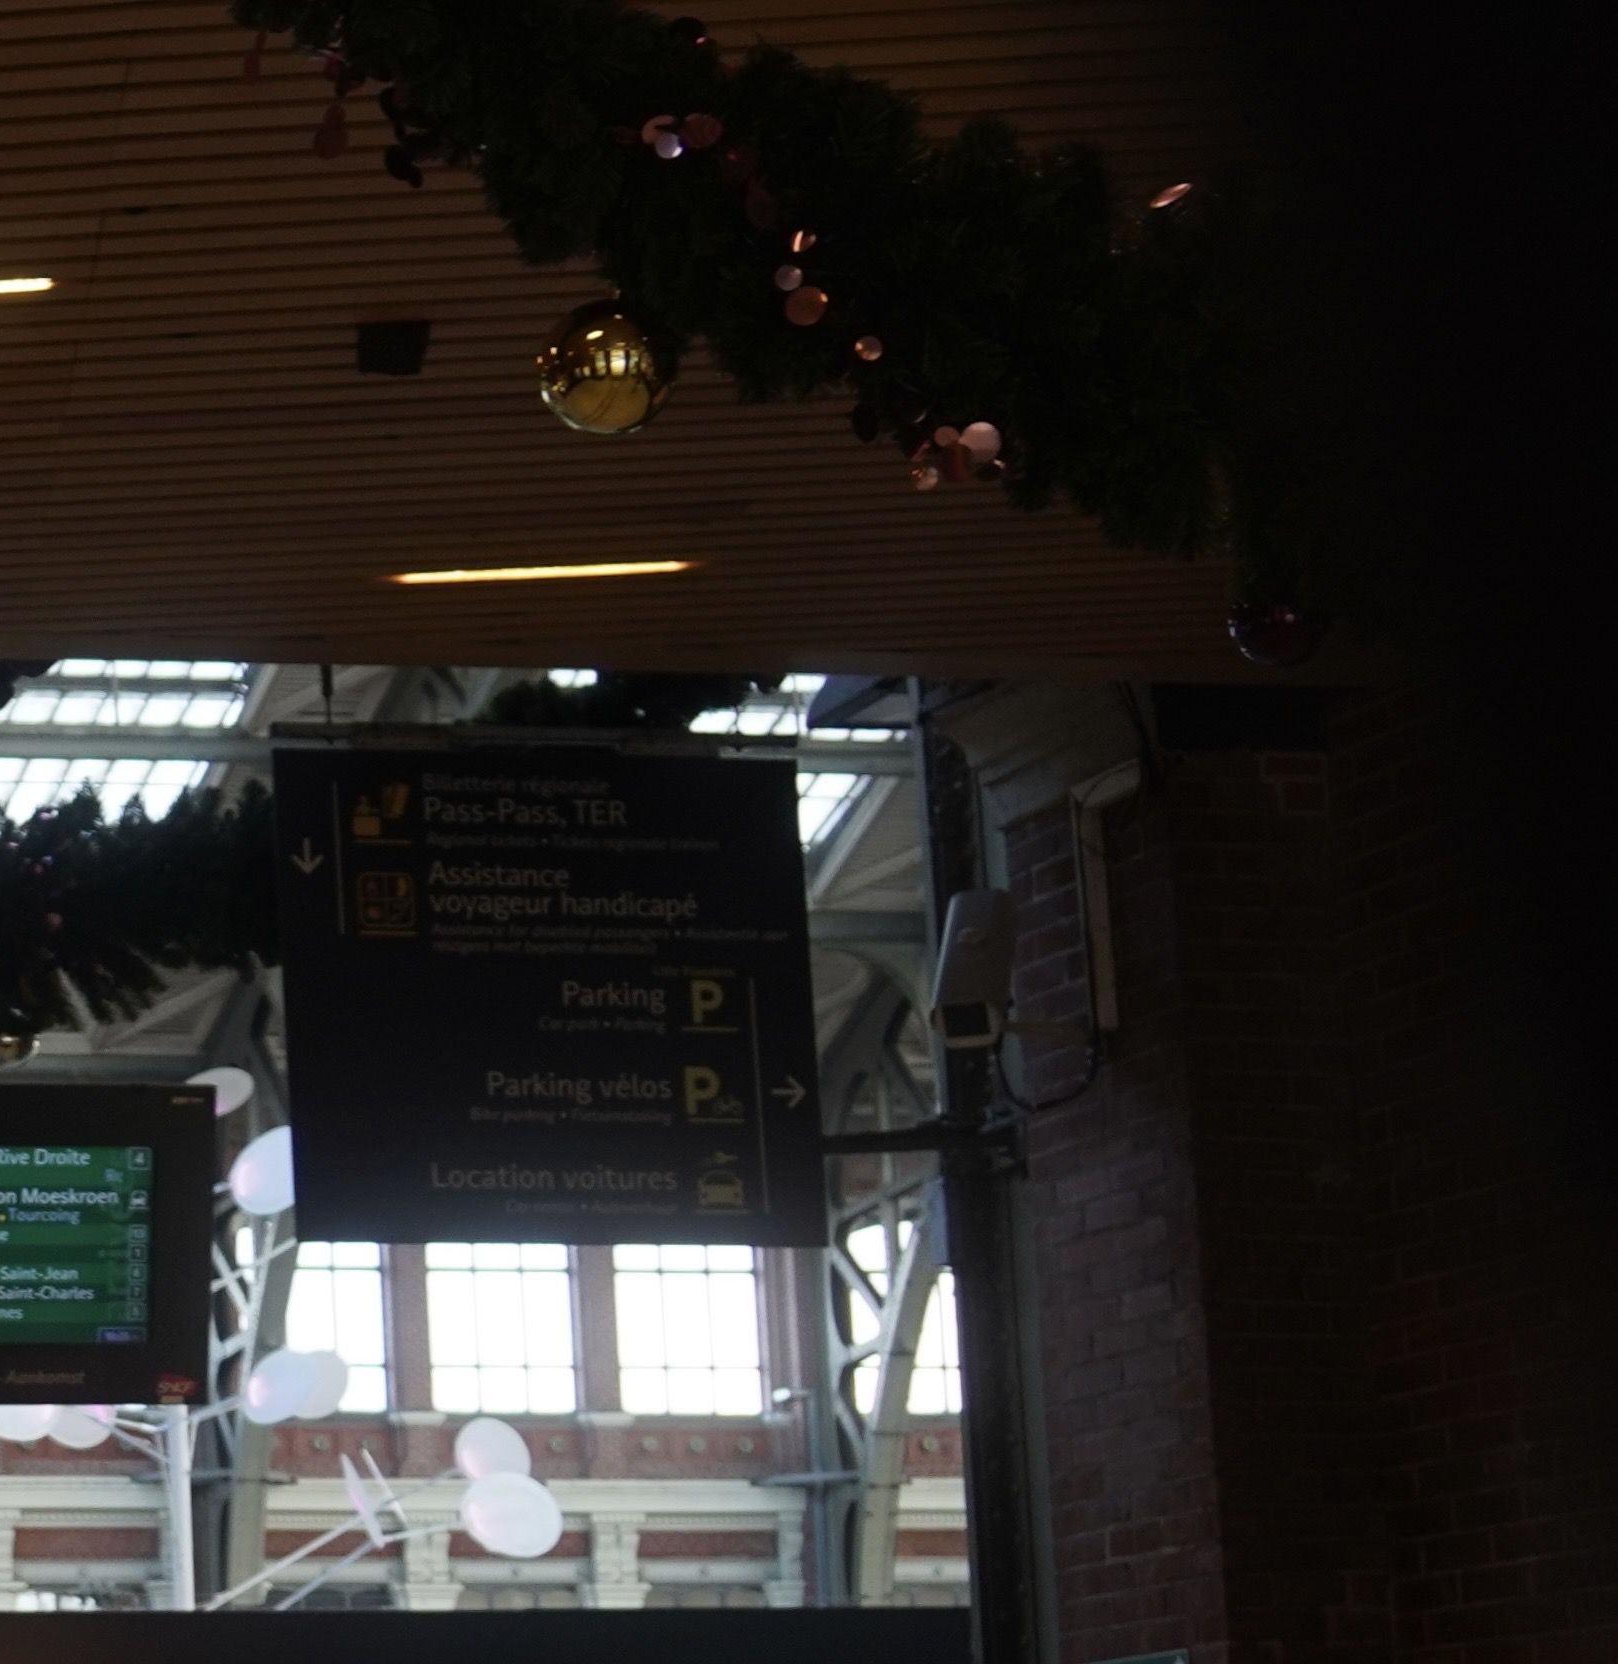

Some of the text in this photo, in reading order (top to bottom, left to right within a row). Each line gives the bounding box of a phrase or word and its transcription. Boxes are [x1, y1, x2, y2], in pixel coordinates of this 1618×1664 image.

[423, 796, 628, 829] Pass-Pass, TER
[428, 861, 569, 887] Assistance
[428, 890, 698, 922] voyageur handicapé
[561, 979, 668, 1015] Parking
[485, 1071, 673, 1104] Parking vélos
[34, 1149, 91, 1165] Droite
[429, 1163, 678, 1191] Location voitures
[22, 1189, 119, 1206] Moeskroen
[8, 1209, 81, 1225] Tourcoing
[0, 1266, 79, 1281] Saint-Jean
